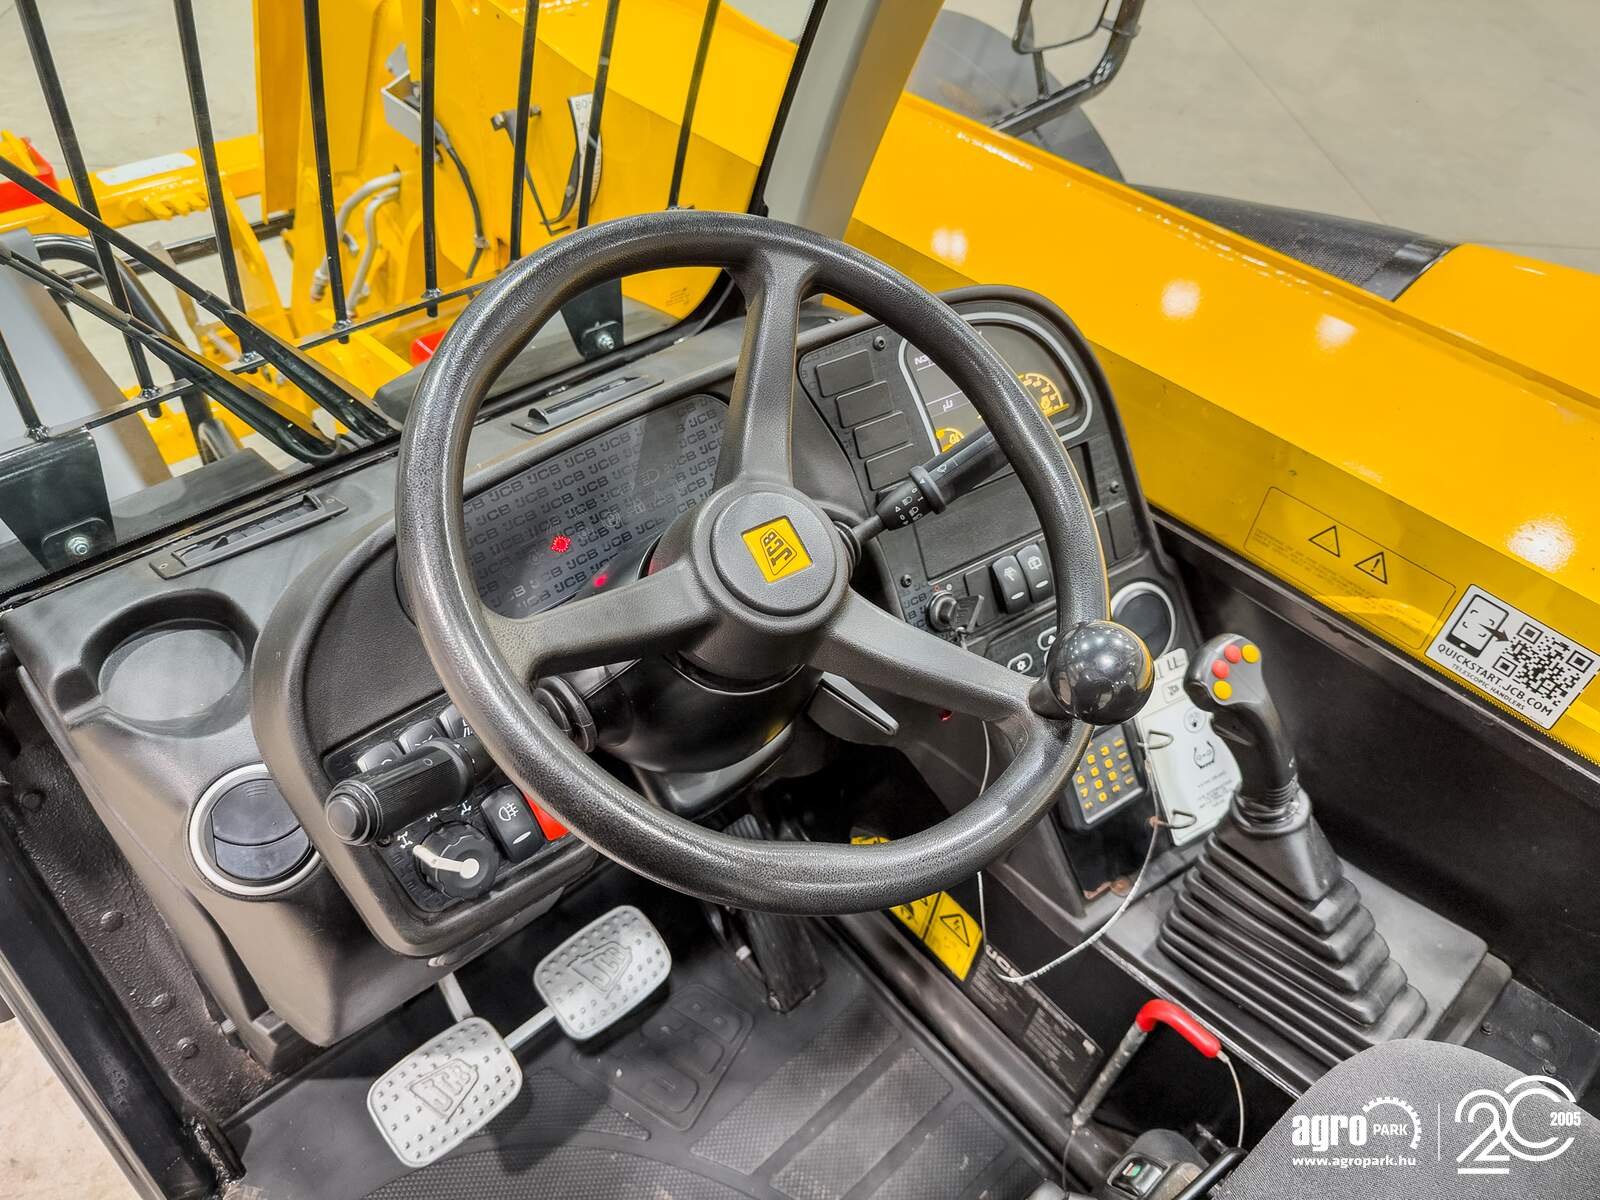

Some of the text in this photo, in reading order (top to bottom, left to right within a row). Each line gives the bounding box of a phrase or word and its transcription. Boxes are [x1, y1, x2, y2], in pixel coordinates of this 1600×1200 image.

[688, 409, 717, 428] JCB
[488, 481, 524, 501] JCB
[527, 464, 561, 484] JCB
[564, 448, 598, 468] JCB
[600, 432, 631, 452] JCB
[689, 456, 717, 476] JCB
[476, 454, 620, 525] JCB JCB JCB JCB
[502, 510, 537, 531] JCB
[541, 493, 574, 514] JCB
[576, 476, 608, 497] JCB
[566, 548, 599, 570] JCB
[602, 531, 632, 552] JCB
[763, 532, 793, 567] JCB
[554, 571, 587, 593] JCB
[1437, 643, 1553, 716] QUICKSTART.JCB.COM
[1490, 686, 1526, 711] HANDLERS
[421, 1065, 471, 1112] JCB
